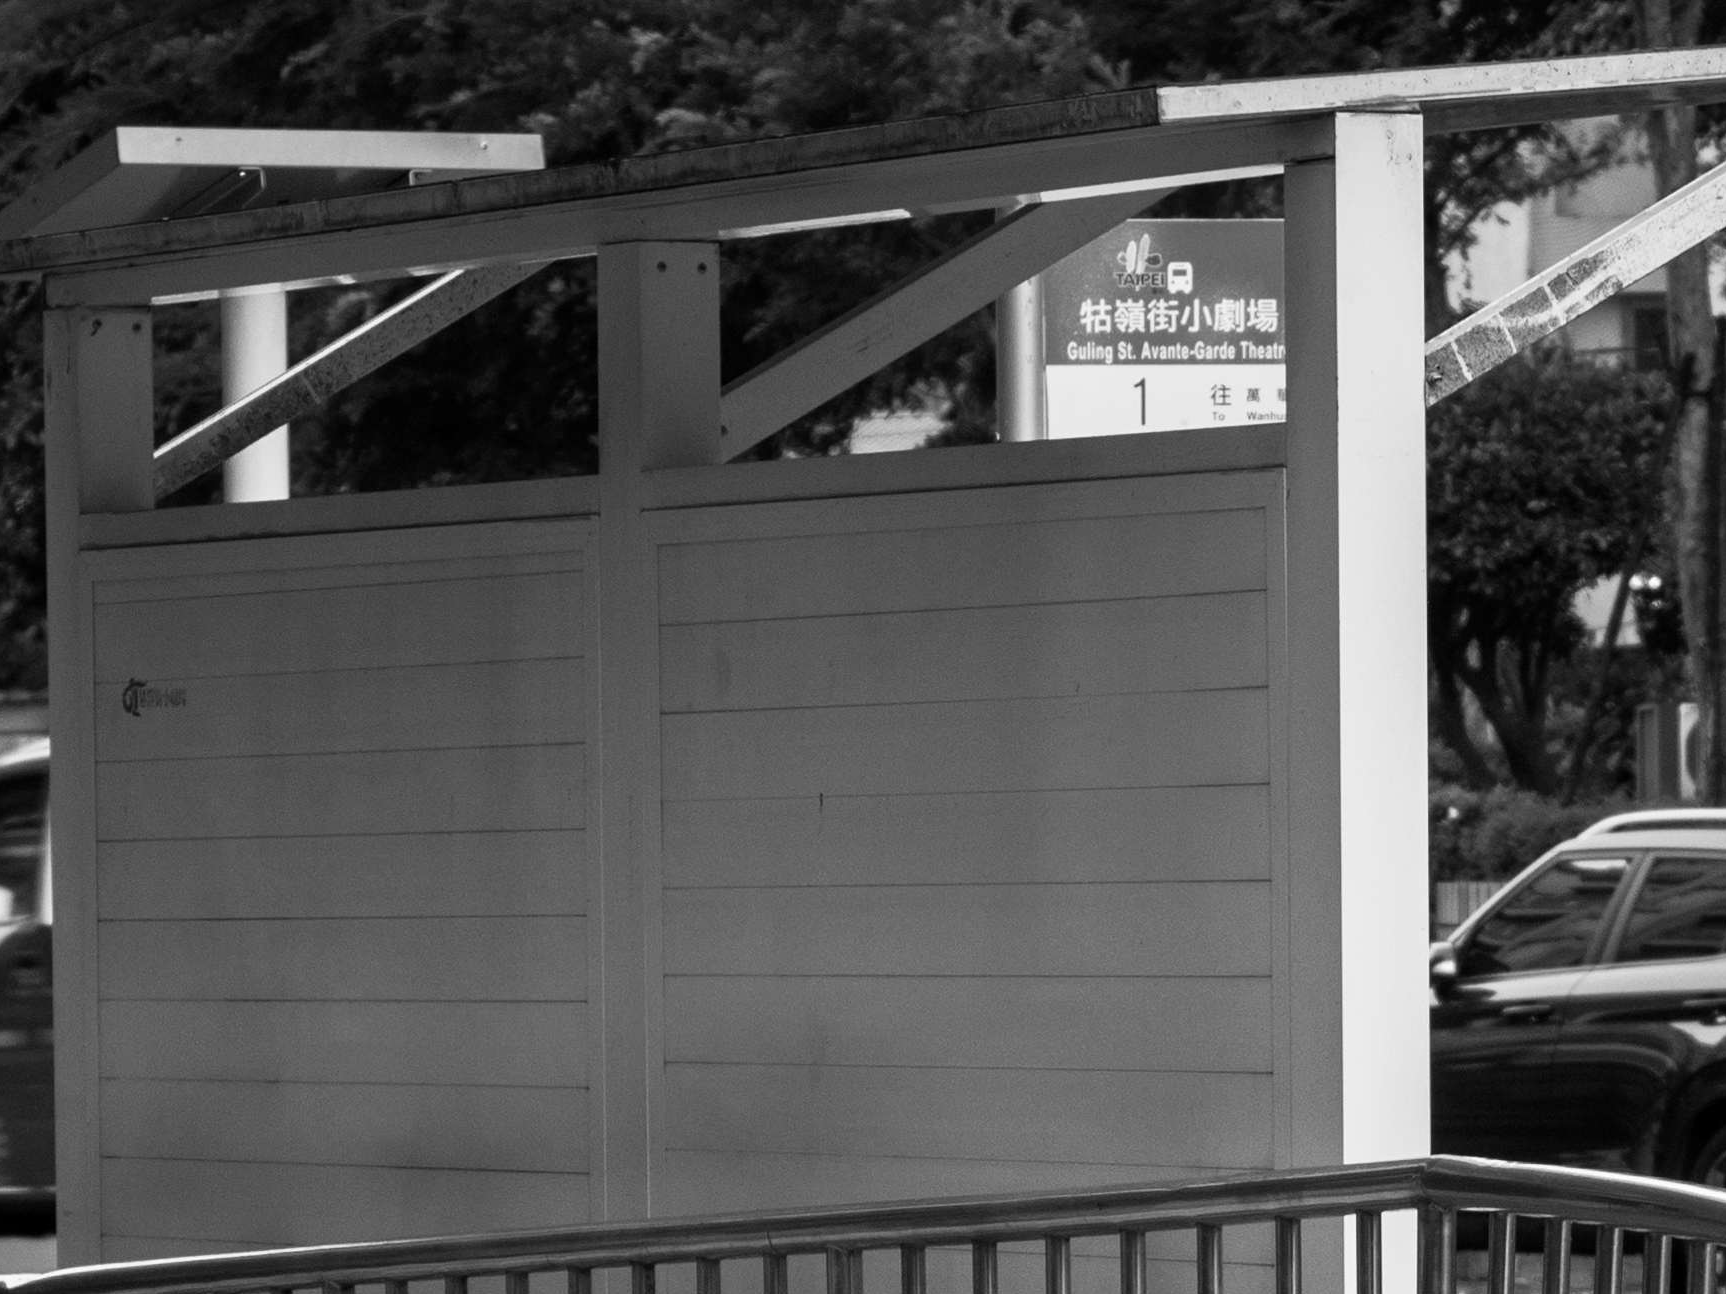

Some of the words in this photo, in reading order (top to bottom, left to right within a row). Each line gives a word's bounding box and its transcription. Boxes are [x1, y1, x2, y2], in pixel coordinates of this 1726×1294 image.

[1114, 272, 1165, 287] TAIPEI
[1079, 297, 1279, 333] 牯嶺街小劇場
[1067, 341, 1113, 363] Guling
[1117, 342, 1136, 360] St.
[1141, 340, 1236, 361] Avante-Garde
[1240, 340, 1286, 361] Theatr
[1133, 377, 1147, 426] 1
[1210, 384, 1232, 407] 往
[1246, 409, 1286, 421] Wanhu
